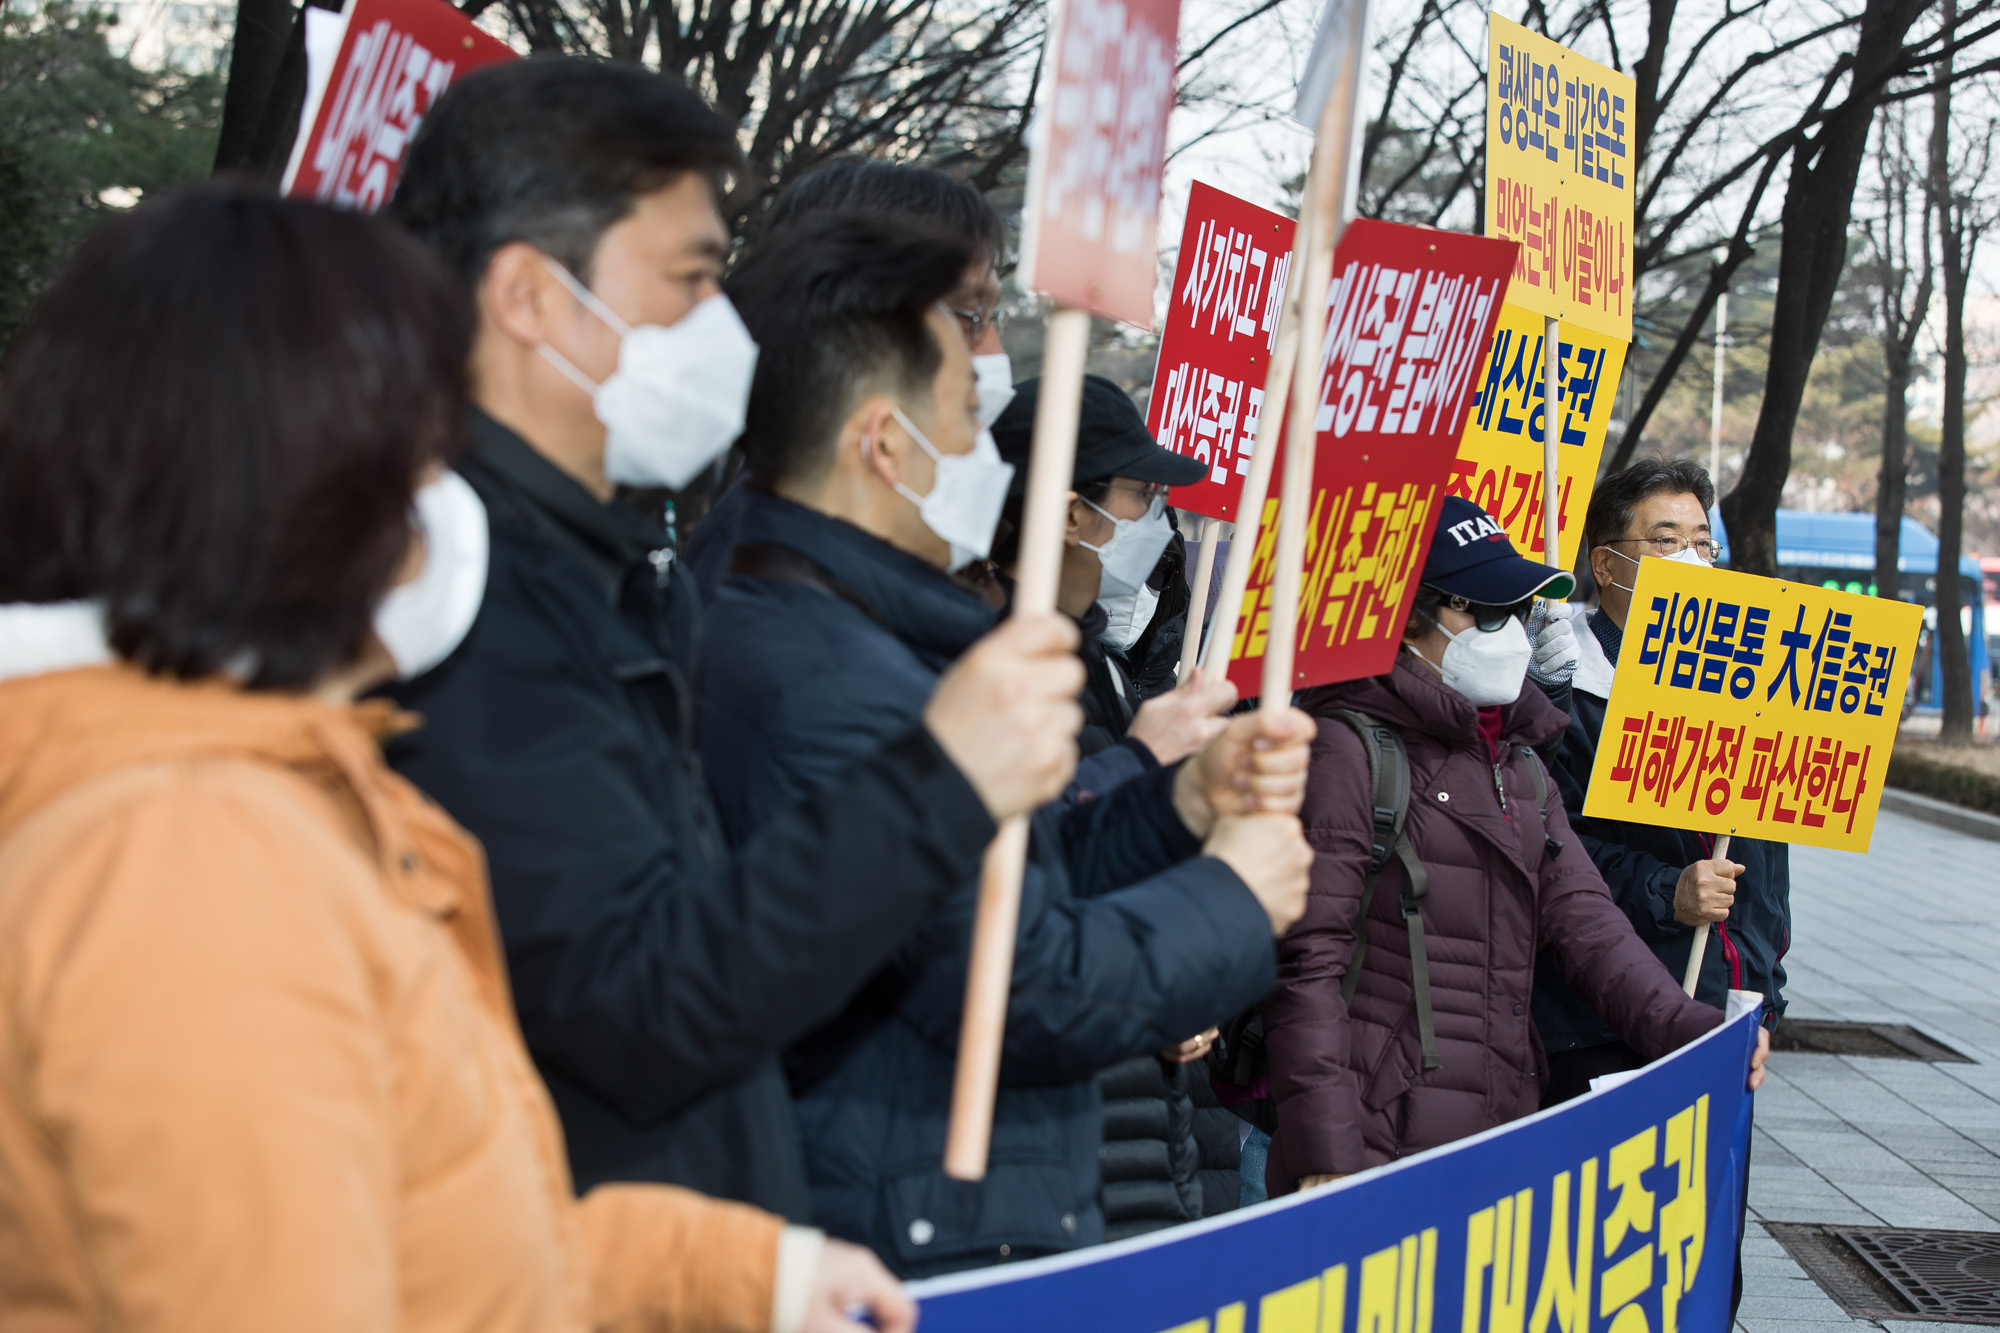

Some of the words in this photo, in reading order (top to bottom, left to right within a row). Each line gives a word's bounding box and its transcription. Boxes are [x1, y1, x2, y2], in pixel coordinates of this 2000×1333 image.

[1498, 43, 1561, 163] 평생모은
[1564, 76, 1626, 190] 피같은돈
[1182, 219, 1268, 342] 사기치고
[1261, 250, 1294, 356] 배
[1562, 204, 1625, 317] 이꼴이냐
[1312, 260, 1421, 439] 대신증권
[1379, 269, 1500, 436] 불법사기
[1471, 328, 1607, 448] 대신증권
[1156, 361, 1244, 486] 대신증권
[1320, 481, 1437, 648] 촉구한다
[1447, 514, 1507, 547] ITAL
[1638, 591, 1771, 701] 라임몸통
[1766, 603, 1897, 717] 大信증권
[1610, 710, 1747, 816] 피해가정
[1740, 730, 1872, 835] 파산한다
